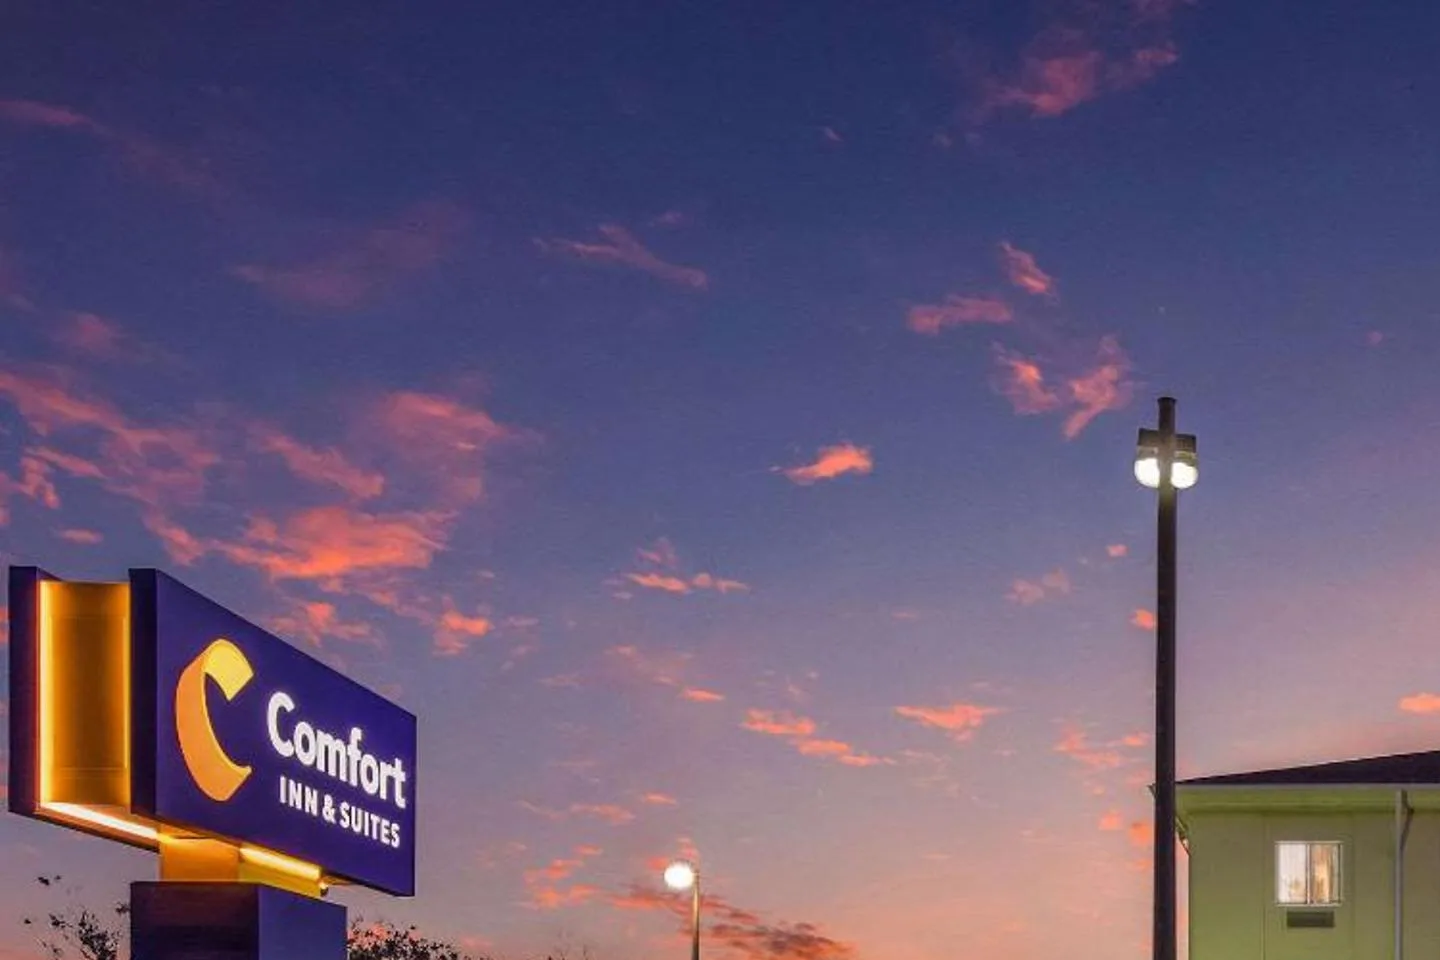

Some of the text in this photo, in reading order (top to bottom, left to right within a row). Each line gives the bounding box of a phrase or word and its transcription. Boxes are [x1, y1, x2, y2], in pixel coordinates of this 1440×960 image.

[267, 691, 406, 809] Comfort
[280, 776, 400, 848] INN & SUITES
